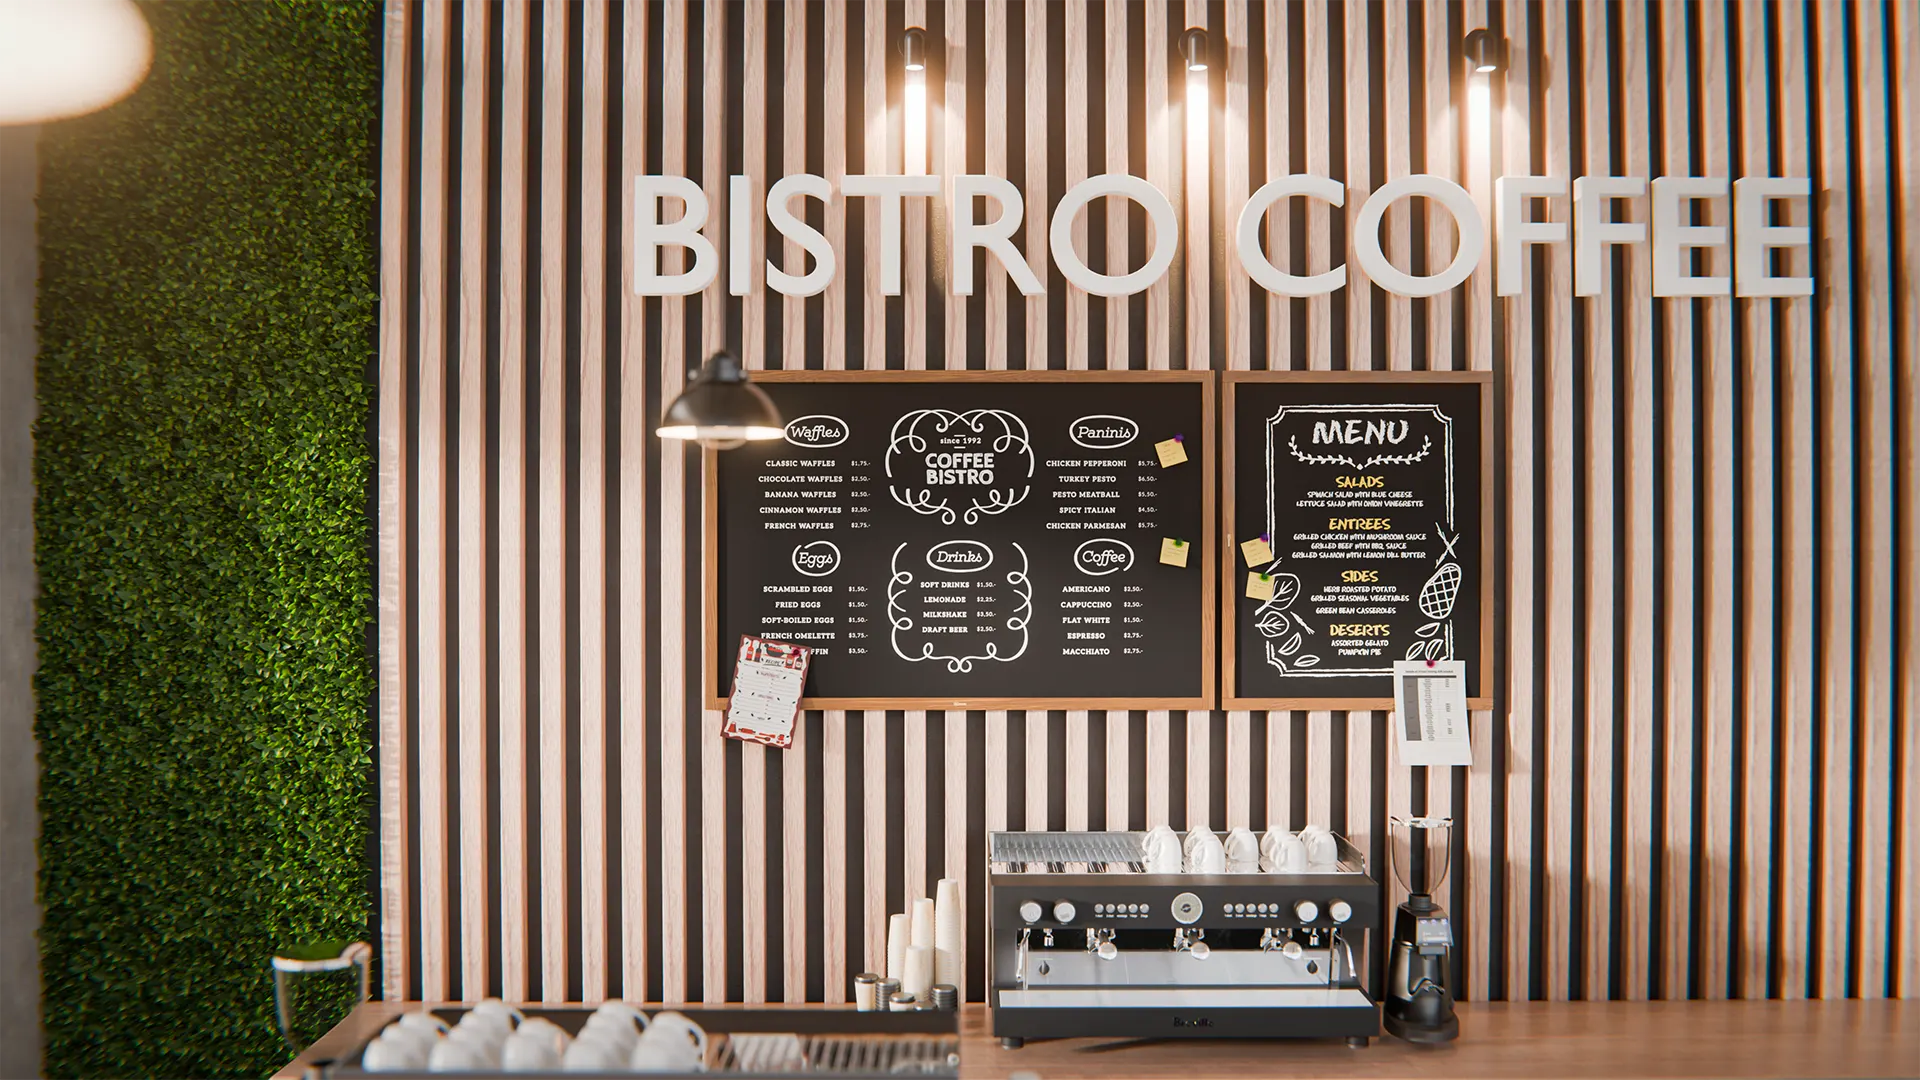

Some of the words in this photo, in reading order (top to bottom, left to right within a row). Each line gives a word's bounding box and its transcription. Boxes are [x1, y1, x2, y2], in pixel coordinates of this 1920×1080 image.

[633, 172, 1180, 297] BISTRO
[1236, 173, 1814, 298] COFFEE
[791, 425, 841, 441] Waffles
[1077, 427, 1131, 438] Paninis
[1312, 419, 1408, 444] MENU
[940, 437, 960, 445] since
[962, 437, 981, 445] 1992
[925, 453, 995, 468] COFFEE
[926, 470, 994, 485] BISTRO
[1336, 476, 1384, 488] SALADS
[1329, 518, 1390, 530] ENTREES
[798, 552, 833, 568] Eggs
[937, 551, 983, 563] Drinks
[1082, 550, 1125, 566] Coffee
[1341, 570, 1378, 582] SIDES
[761, 632, 792, 640] FRENCH
[1330, 624, 1390, 636] DESERTS
